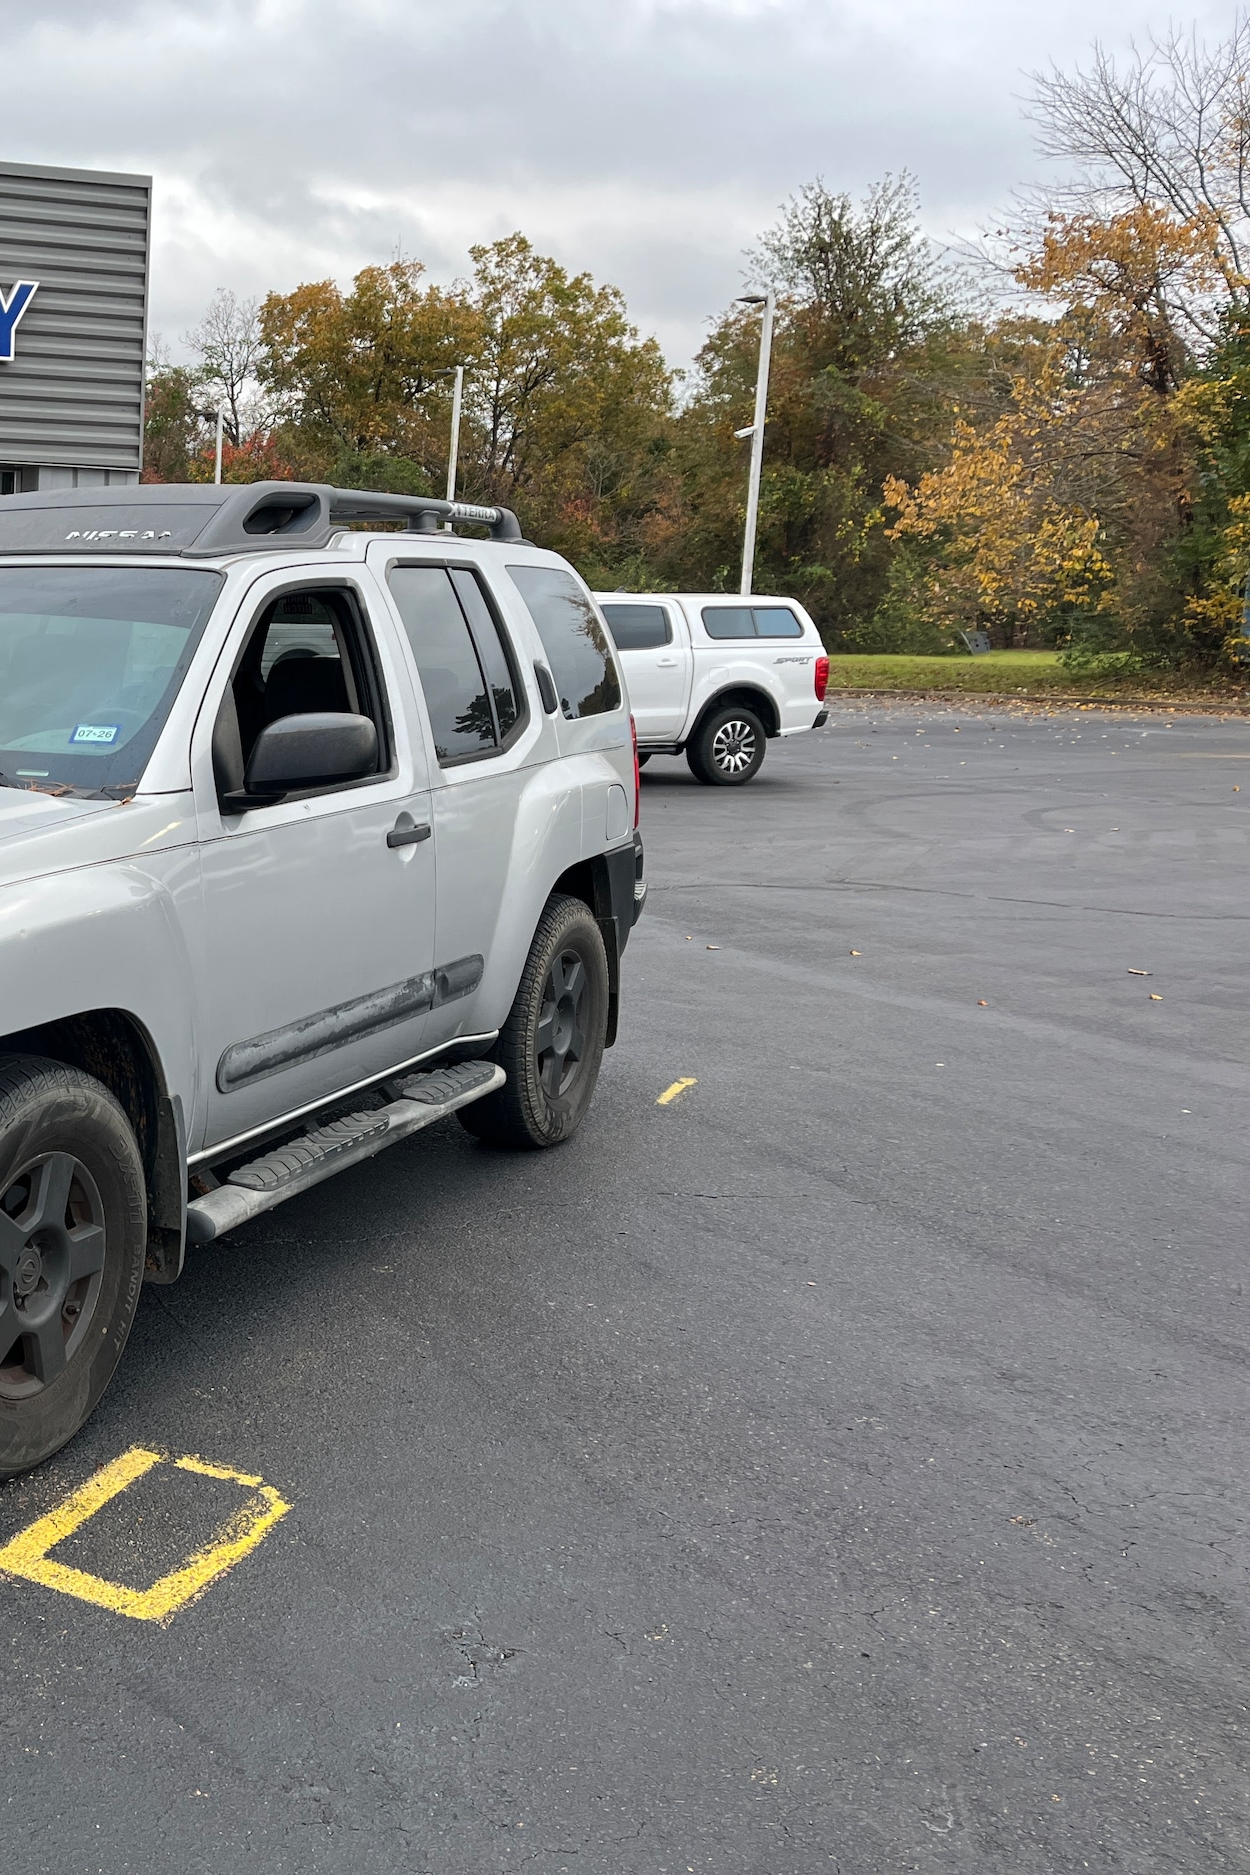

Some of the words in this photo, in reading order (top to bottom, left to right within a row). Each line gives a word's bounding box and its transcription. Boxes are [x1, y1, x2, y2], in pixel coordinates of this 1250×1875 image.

[447, 502, 497, 522] XTERRA
[772, 656, 814, 665] SPORT
[125, 1244, 143, 1314] BANDIT
